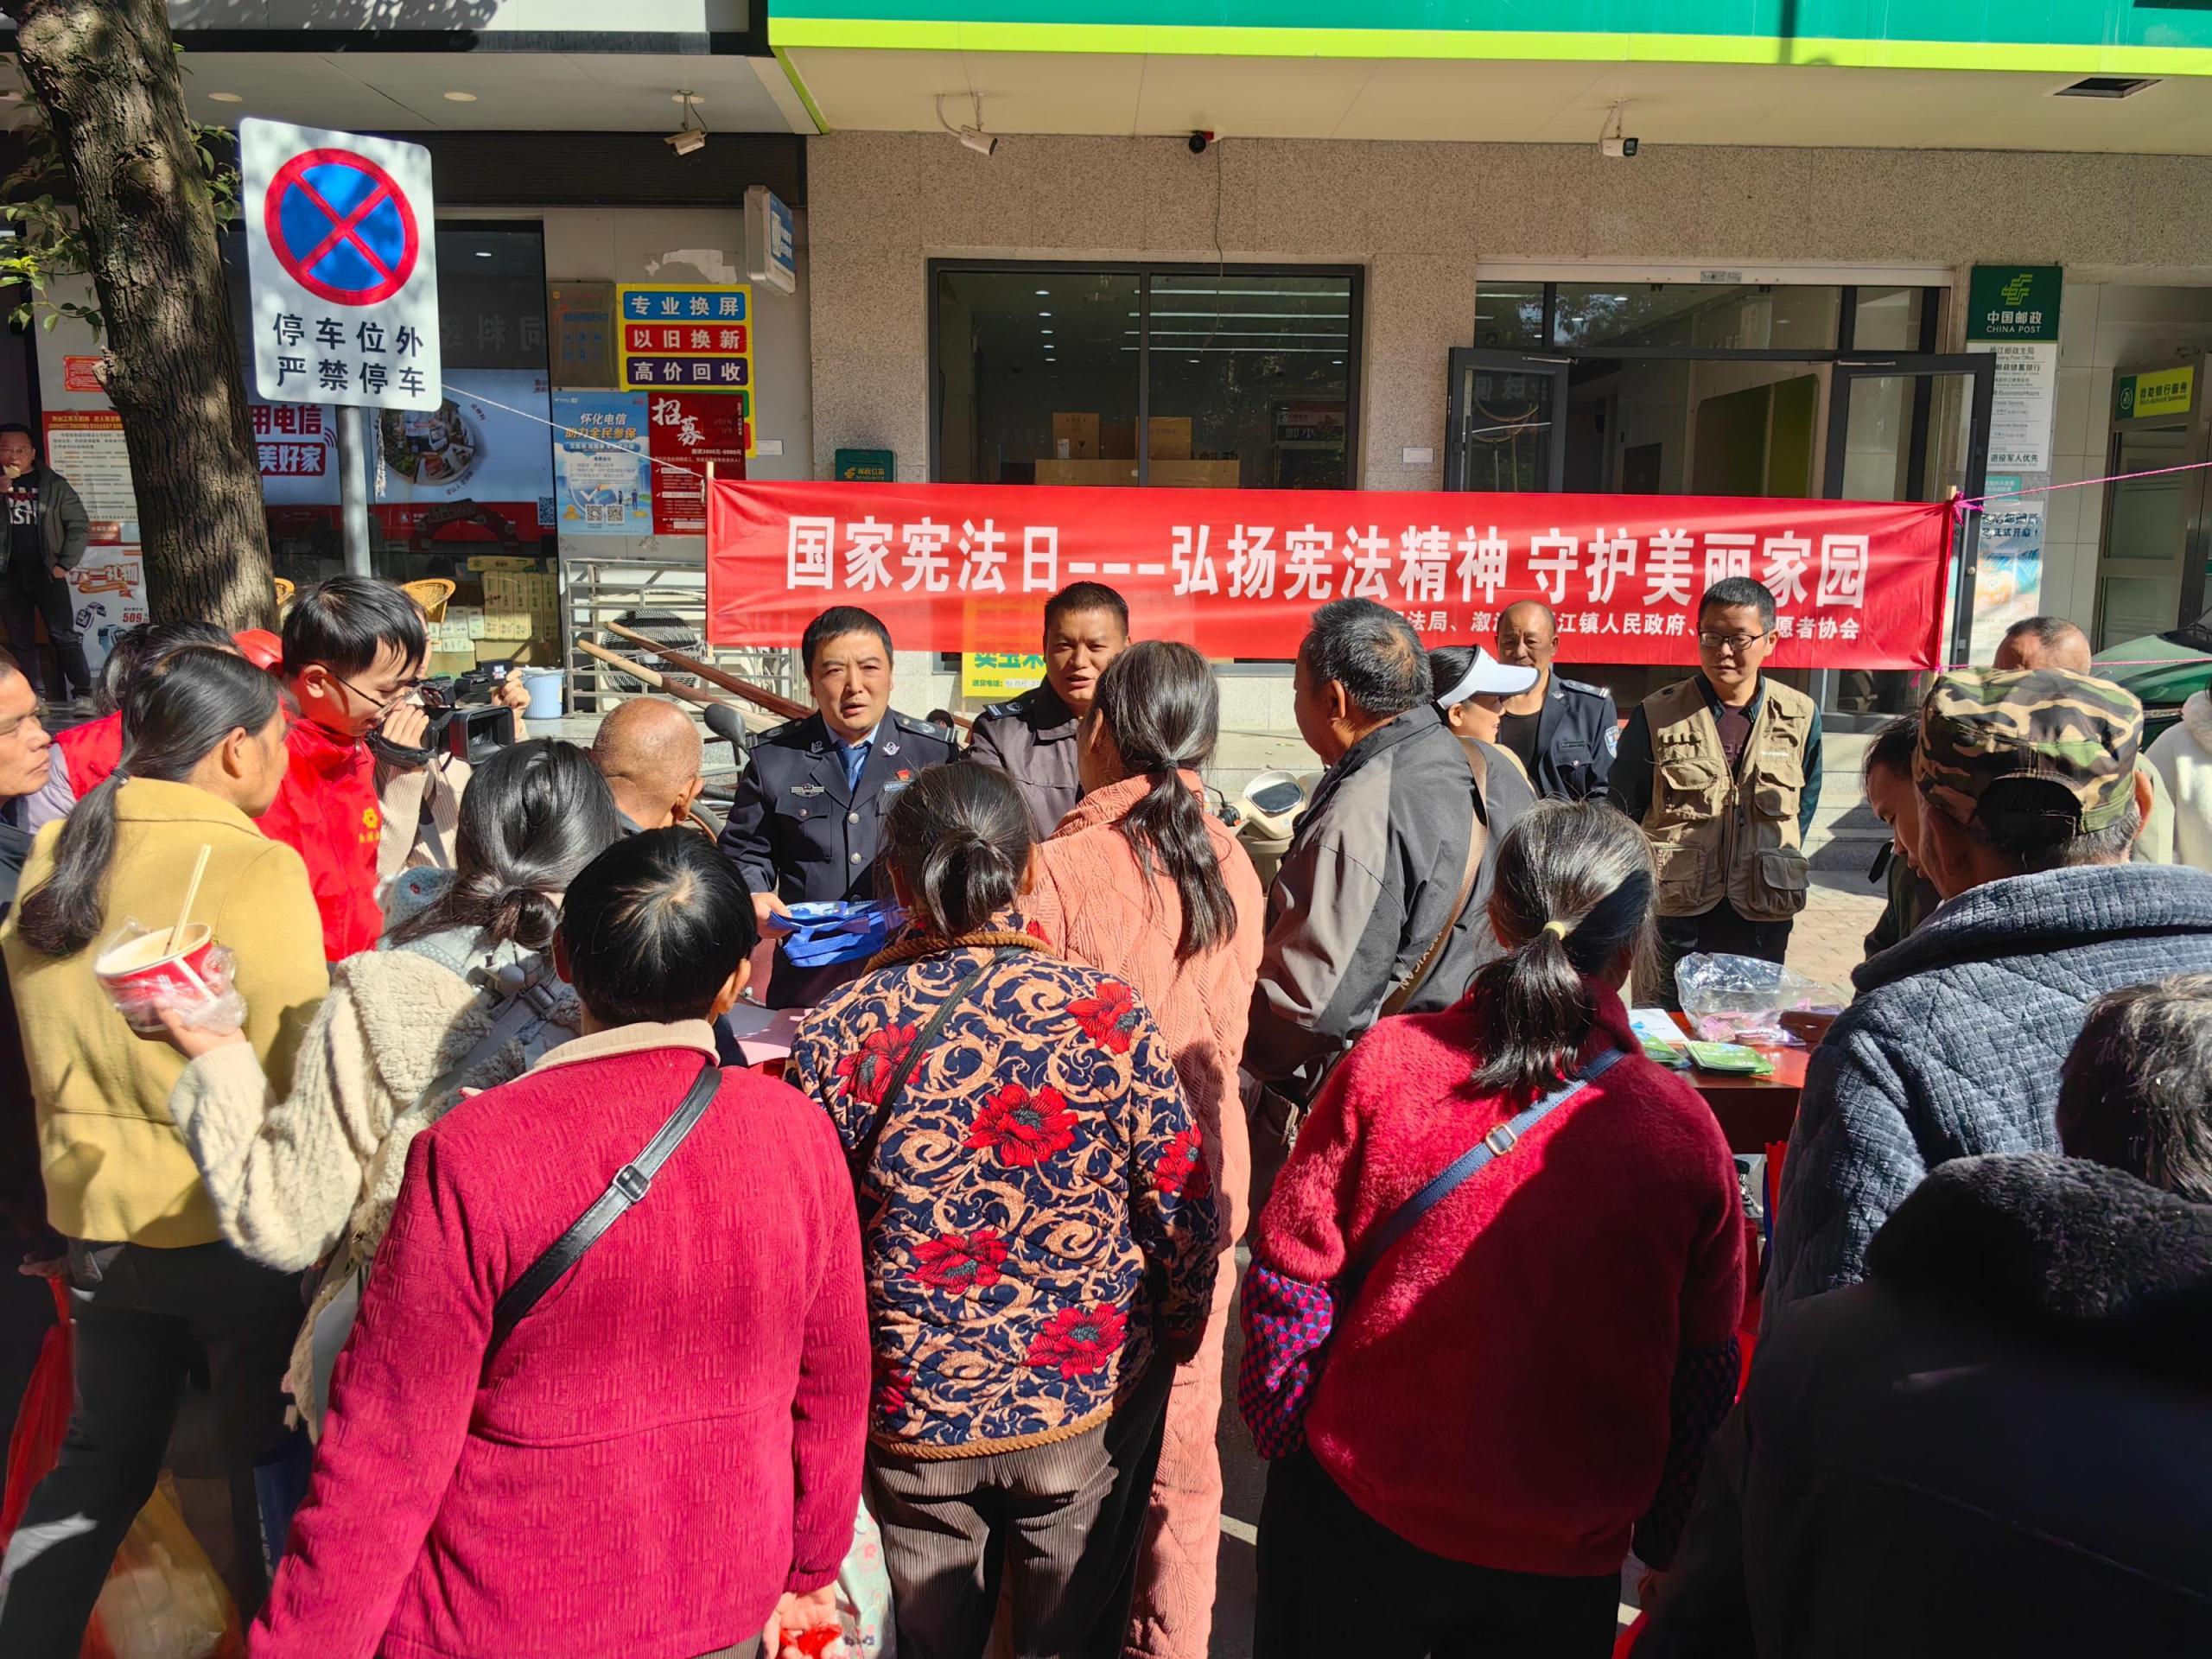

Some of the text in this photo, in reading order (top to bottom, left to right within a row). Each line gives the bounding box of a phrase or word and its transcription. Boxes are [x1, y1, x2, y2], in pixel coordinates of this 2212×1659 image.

[631, 296, 739, 316] 专业换屏
[1986, 309, 2043, 325] 中国邮政
[273, 313, 423, 357] 停车位外
[632, 330, 740, 350] 以旧换新
[276, 356, 426, 397] 严禁停车
[633, 362, 741, 381] 高价回收
[580, 412, 627, 426] 怀化电信
[651, 397, 705, 446] 招募
[566, 426, 637, 440] 助力全民参保
[257, 445, 321, 473] 美好家
[1990, 454, 2039, 463] 退役军人优先
[1526, 527, 1870, 609] 守护美丽家园
[123, 612, 143, 623] 509
[1553, 612, 1696, 636] 江镇人民政府、
